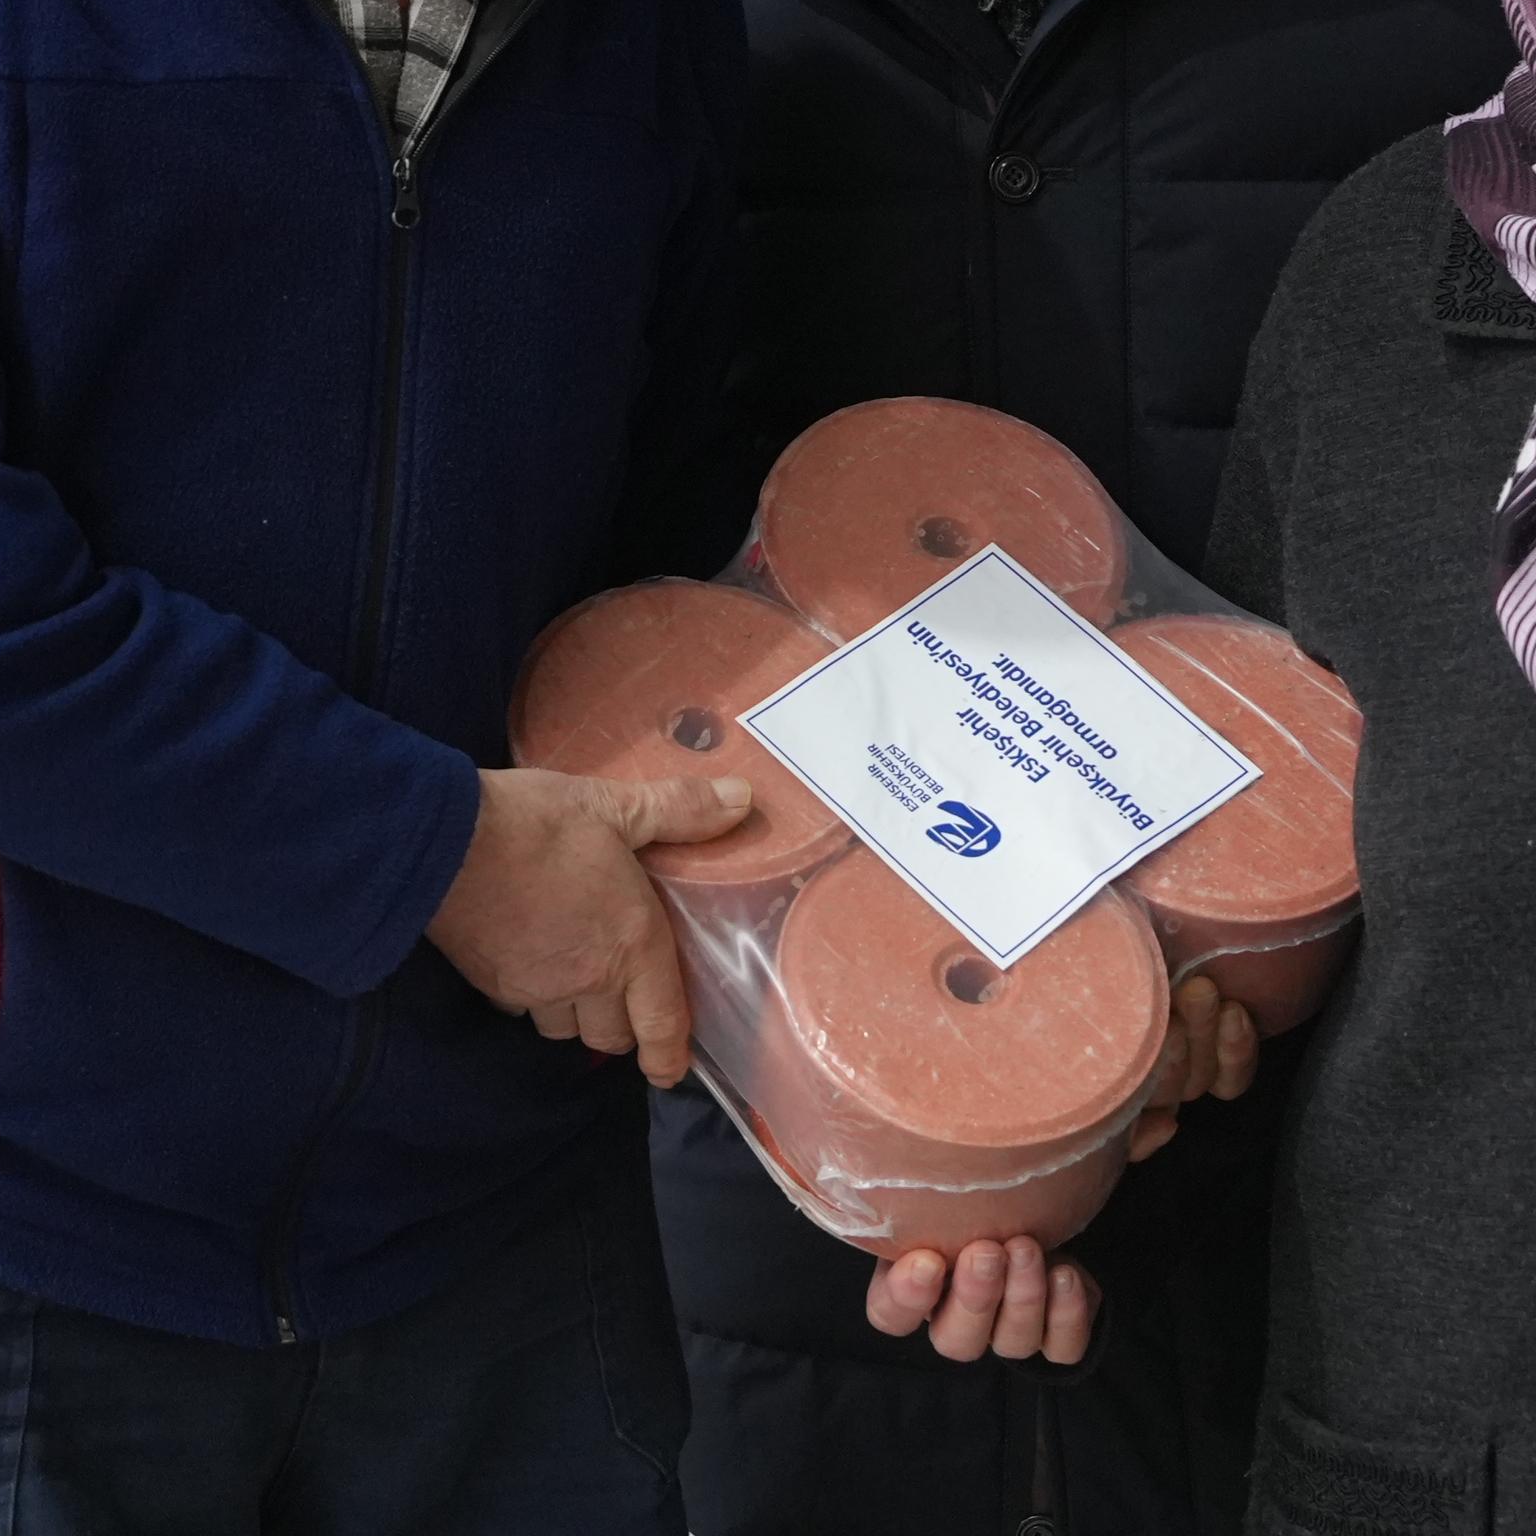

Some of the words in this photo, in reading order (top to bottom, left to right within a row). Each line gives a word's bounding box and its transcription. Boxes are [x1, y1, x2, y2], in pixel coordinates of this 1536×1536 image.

[992, 652, 1120, 761] armağanıdır.
[868, 743, 932, 803] BÜYÜKŞEHİR
[886, 743, 945, 795] BELEDİYESİ
[956, 706, 1052, 784] Eskişehir
[868, 763, 920, 812] ESKİŞEHİR
[1040, 733, 1155, 832] Büyükşehir
